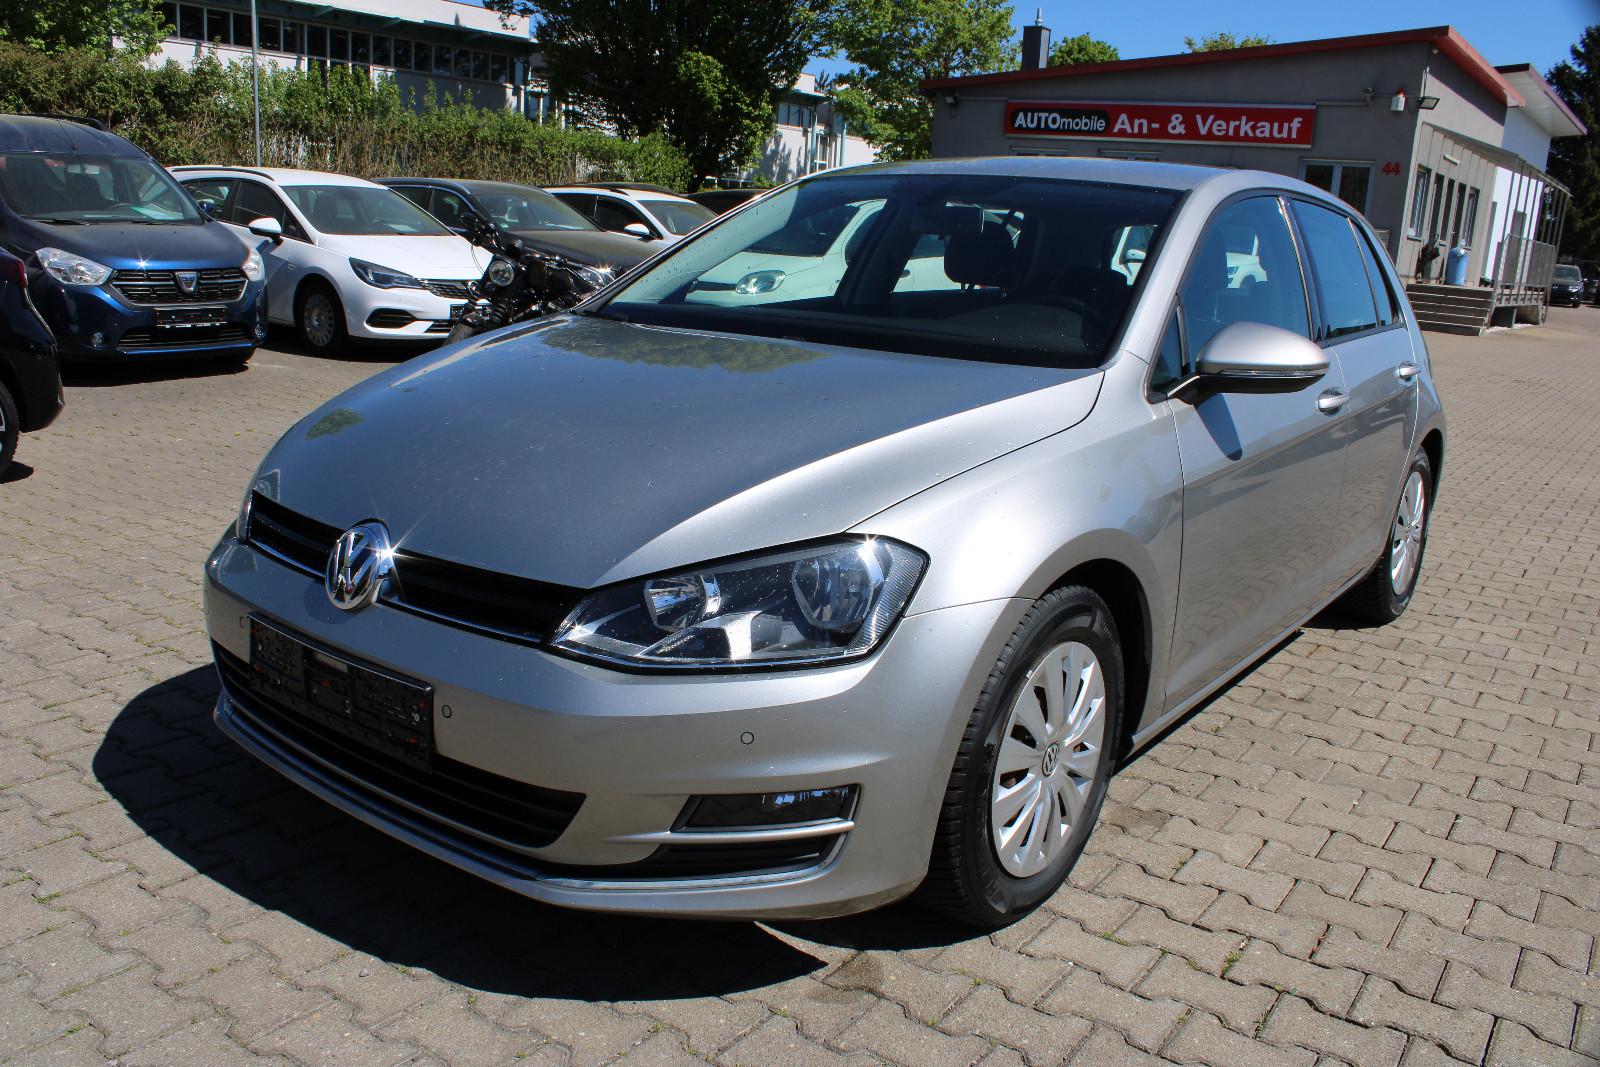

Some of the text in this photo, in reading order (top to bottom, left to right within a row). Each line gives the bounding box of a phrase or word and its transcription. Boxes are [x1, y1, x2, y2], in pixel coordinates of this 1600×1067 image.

[1013, 111, 1303, 139] AUTOmobile An- & Verkauf
[1382, 161, 1401, 176] 44
[328, 528, 376, 606] VW
